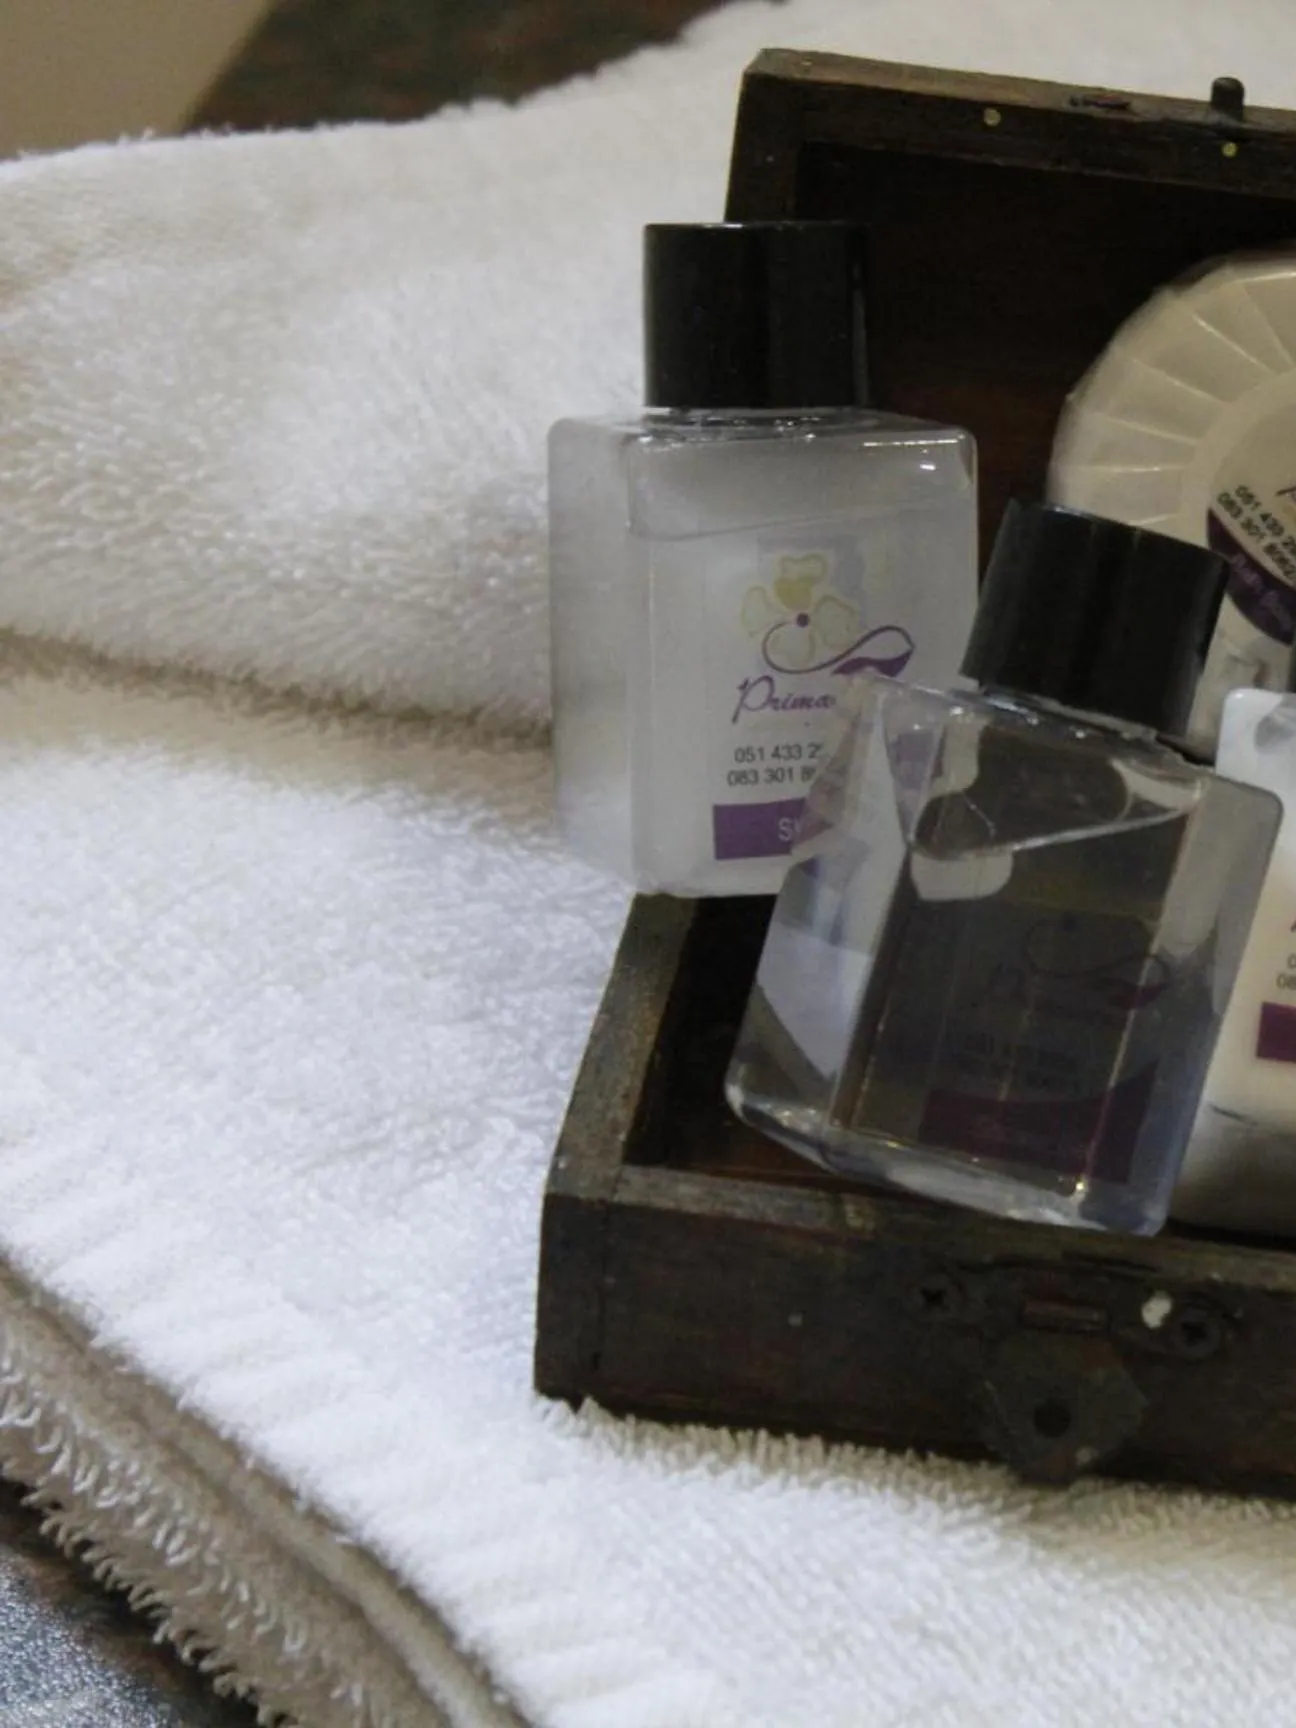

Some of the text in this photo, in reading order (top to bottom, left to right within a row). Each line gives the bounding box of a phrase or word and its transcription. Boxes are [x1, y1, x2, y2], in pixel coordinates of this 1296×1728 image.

[732, 675, 837, 723] Prima
[734, 746, 765, 764] 051
[771, 744, 803, 761] 433
[727, 768, 759, 786] 083
[763, 766, 794, 784] 301
